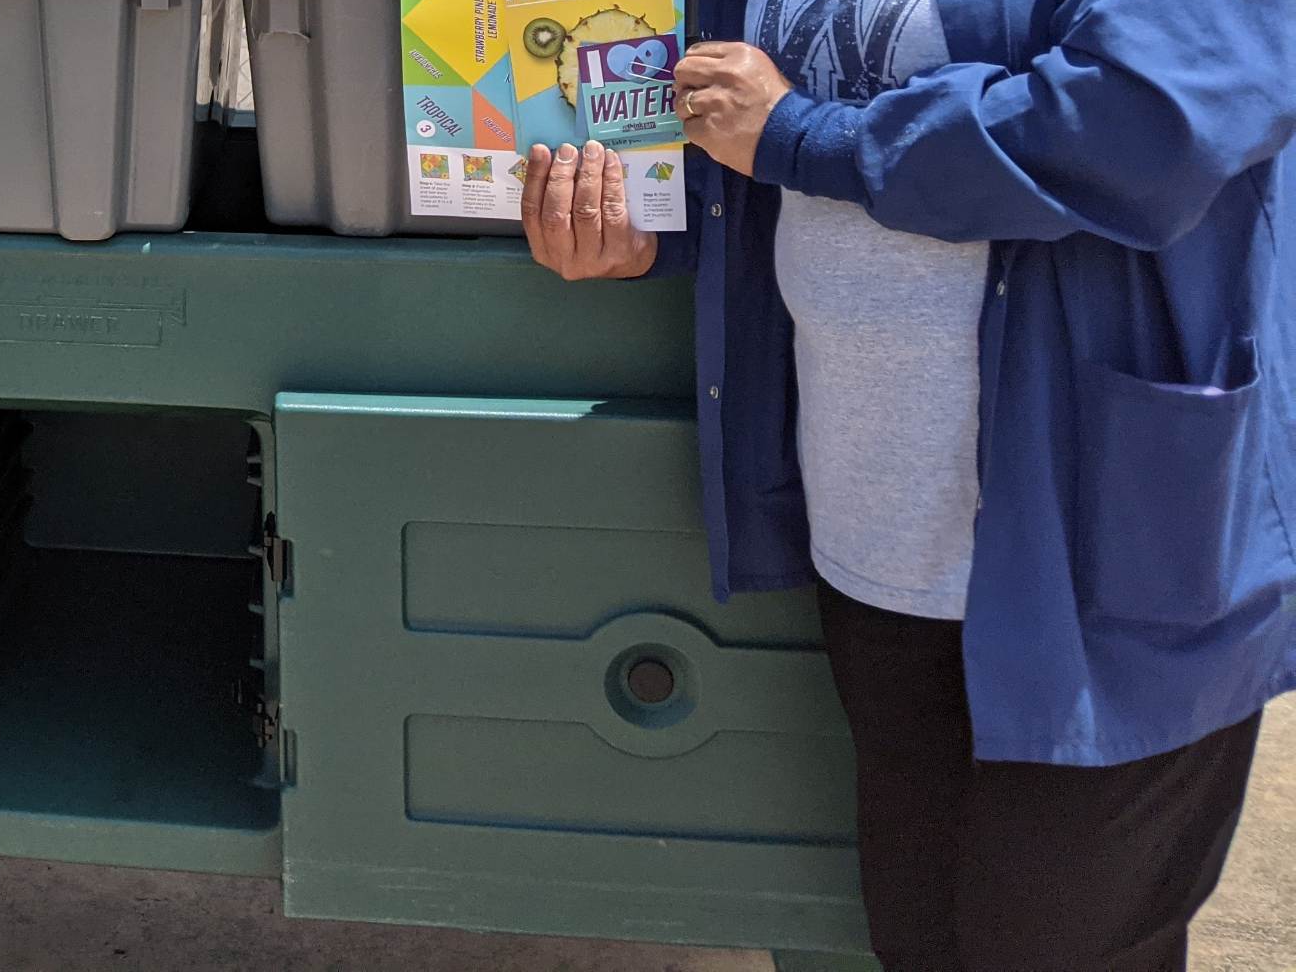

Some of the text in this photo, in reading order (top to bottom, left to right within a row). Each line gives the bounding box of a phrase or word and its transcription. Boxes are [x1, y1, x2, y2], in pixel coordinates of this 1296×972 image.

[487, 0, 498, 39] LEMONADE
[474, 17, 485, 63] STRAWBERRY
[587, 50, 605, 88] I
[416, 95, 464, 137] TROPICAL
[590, 84, 677, 125] WATER
[420, 124, 431, 133] 3
